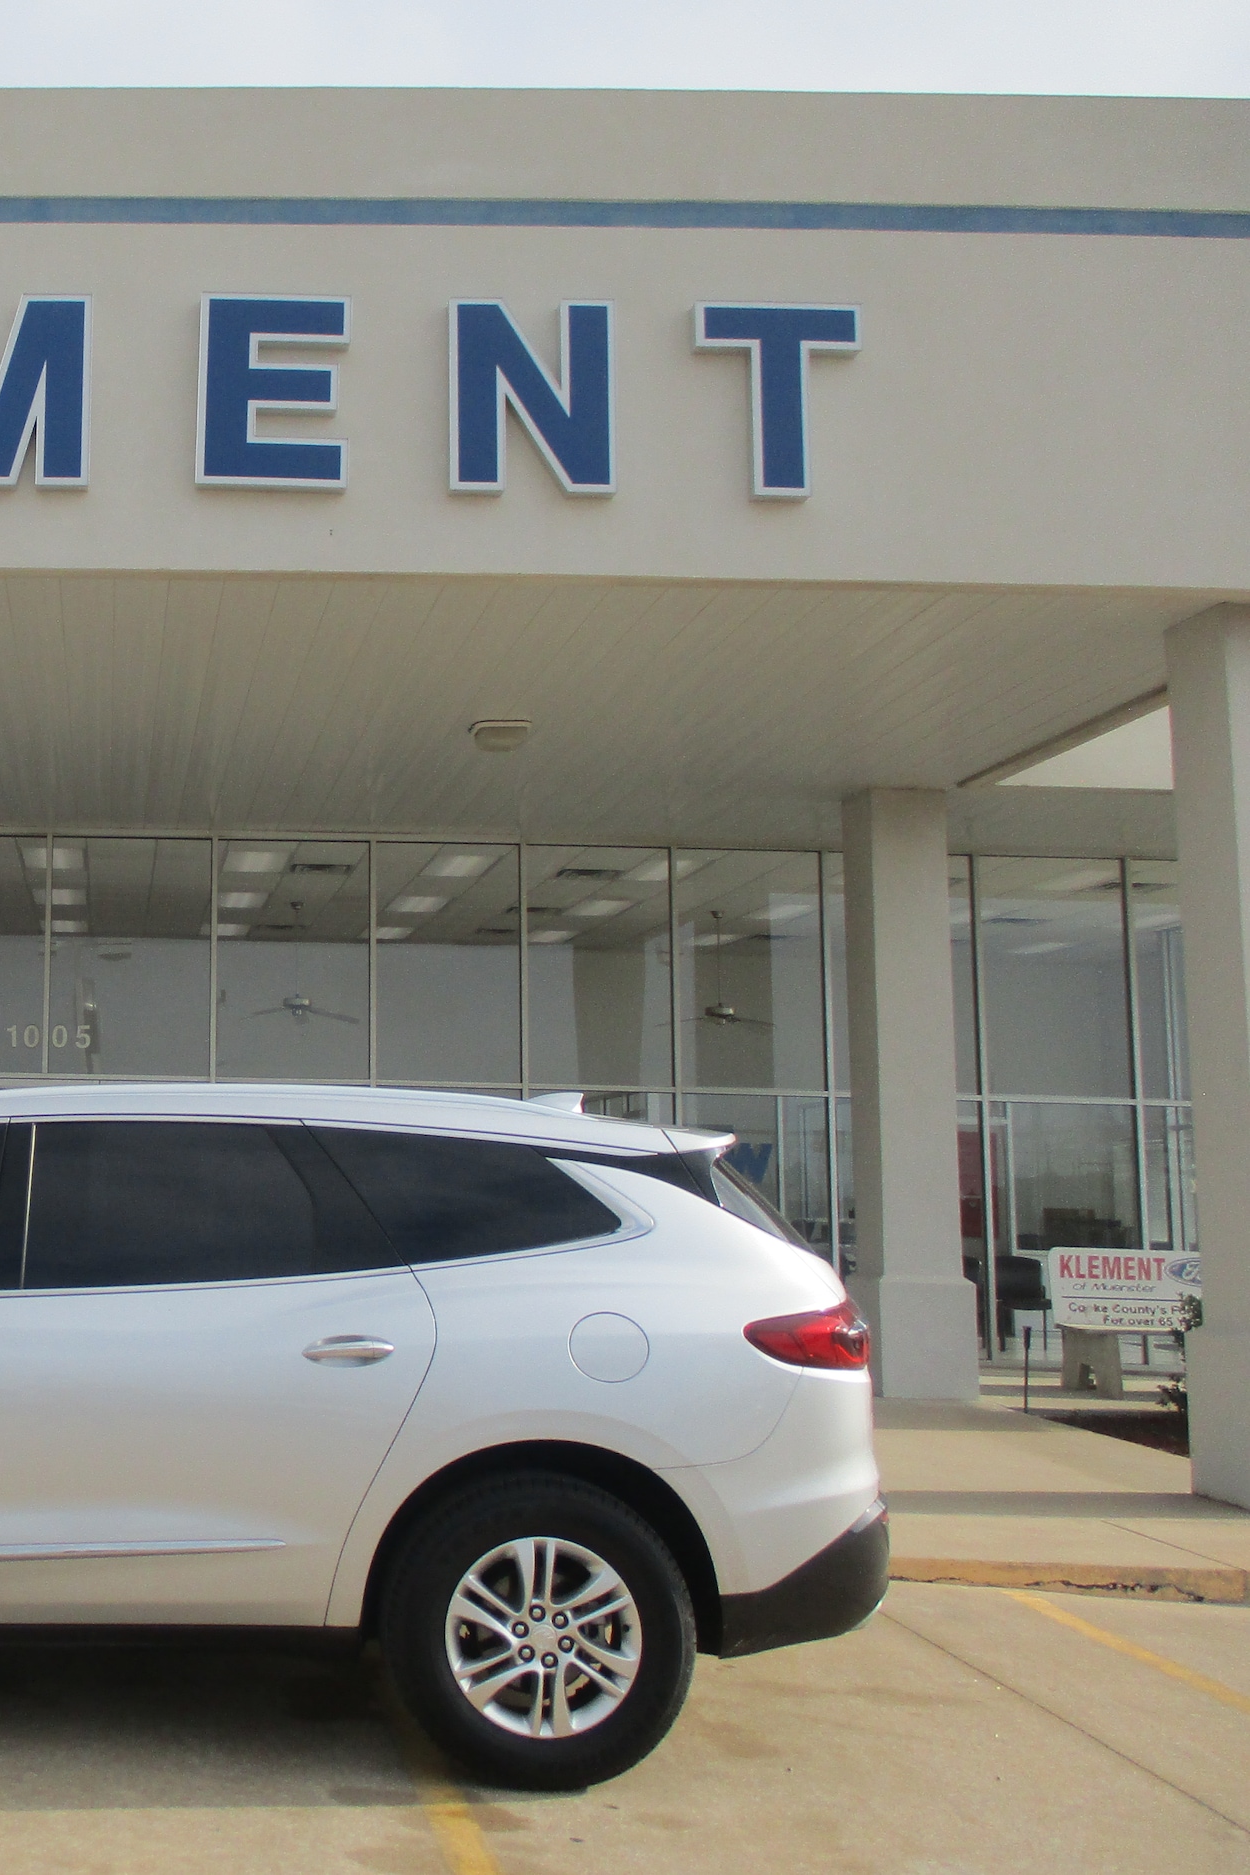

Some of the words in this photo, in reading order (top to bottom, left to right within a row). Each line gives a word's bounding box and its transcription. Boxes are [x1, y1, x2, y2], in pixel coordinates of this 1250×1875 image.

[6, 1024, 92, 1049] 1005
[1059, 1254, 1166, 1281] KLEMENT
[1092, 1283, 1157, 1293] Muenster
[1112, 1304, 1167, 1316] County's
[1103, 1315, 1125, 1324] For
[1128, 1317, 1155, 1326] over
